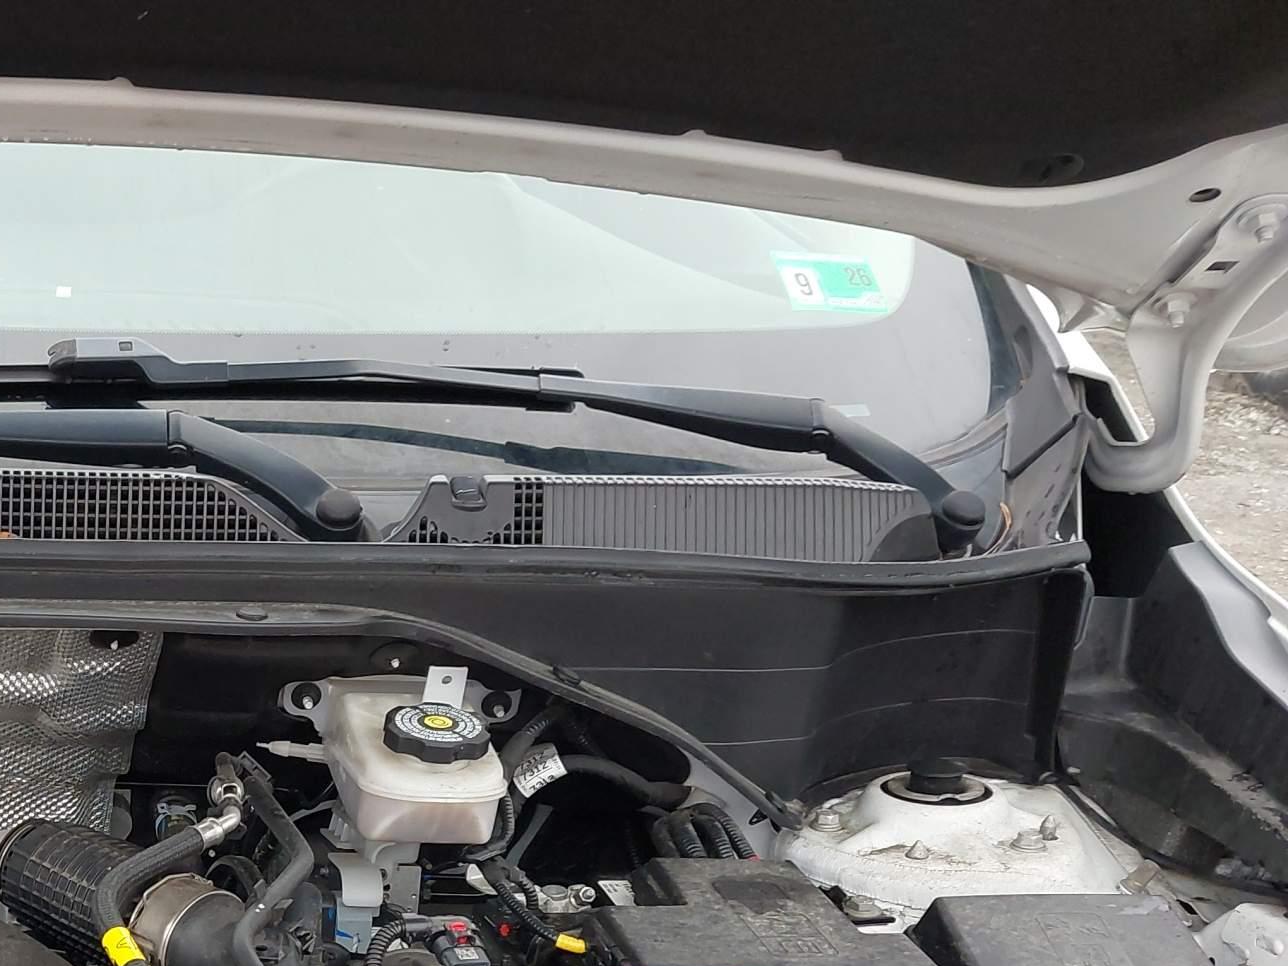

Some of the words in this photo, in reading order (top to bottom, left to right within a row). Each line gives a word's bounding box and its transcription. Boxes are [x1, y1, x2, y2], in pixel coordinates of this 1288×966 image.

[794, 272, 813, 296] 9
[844, 266, 873, 287] 26
[522, 760, 549, 781] 7312
